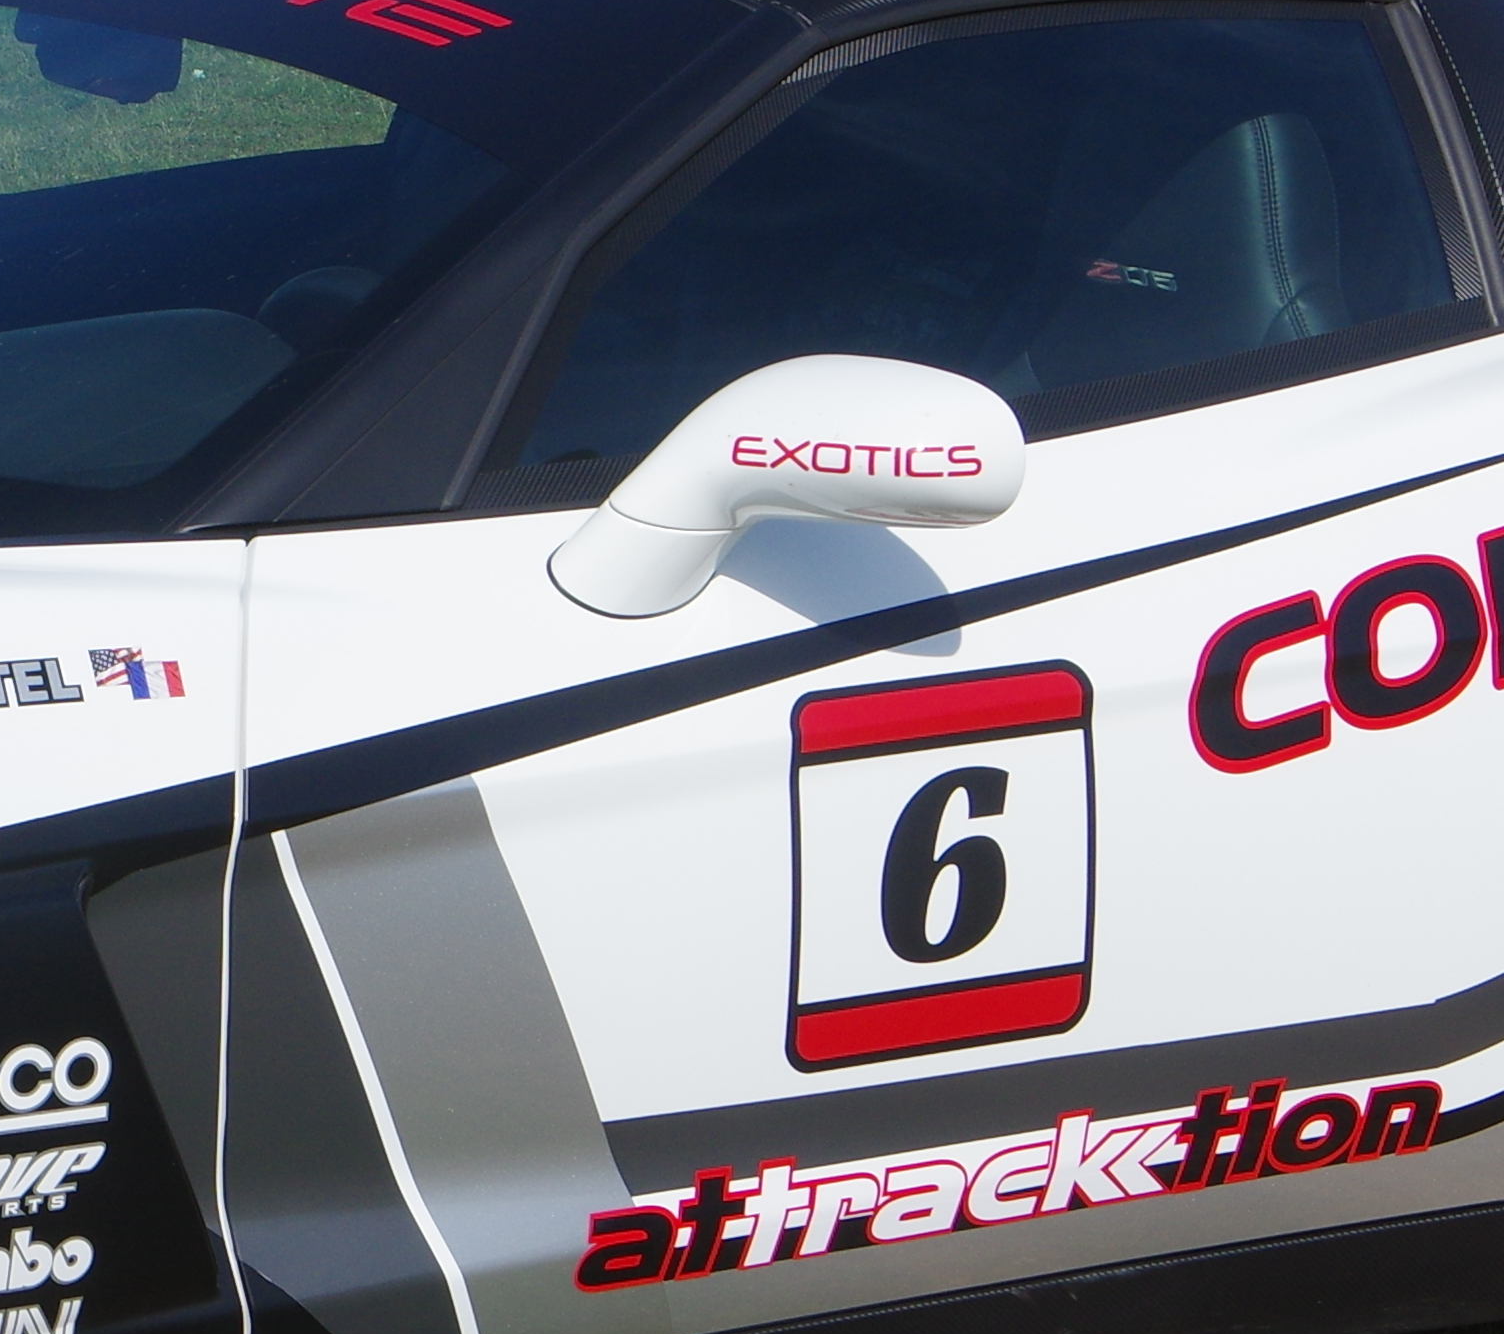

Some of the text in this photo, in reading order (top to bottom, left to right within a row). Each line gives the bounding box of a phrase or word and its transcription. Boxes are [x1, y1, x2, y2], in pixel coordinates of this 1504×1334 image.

[731, 435, 982, 478] EXOTICS
[880, 765, 1010, 964] 6
[573, 1077, 1442, 1294] attracktion
